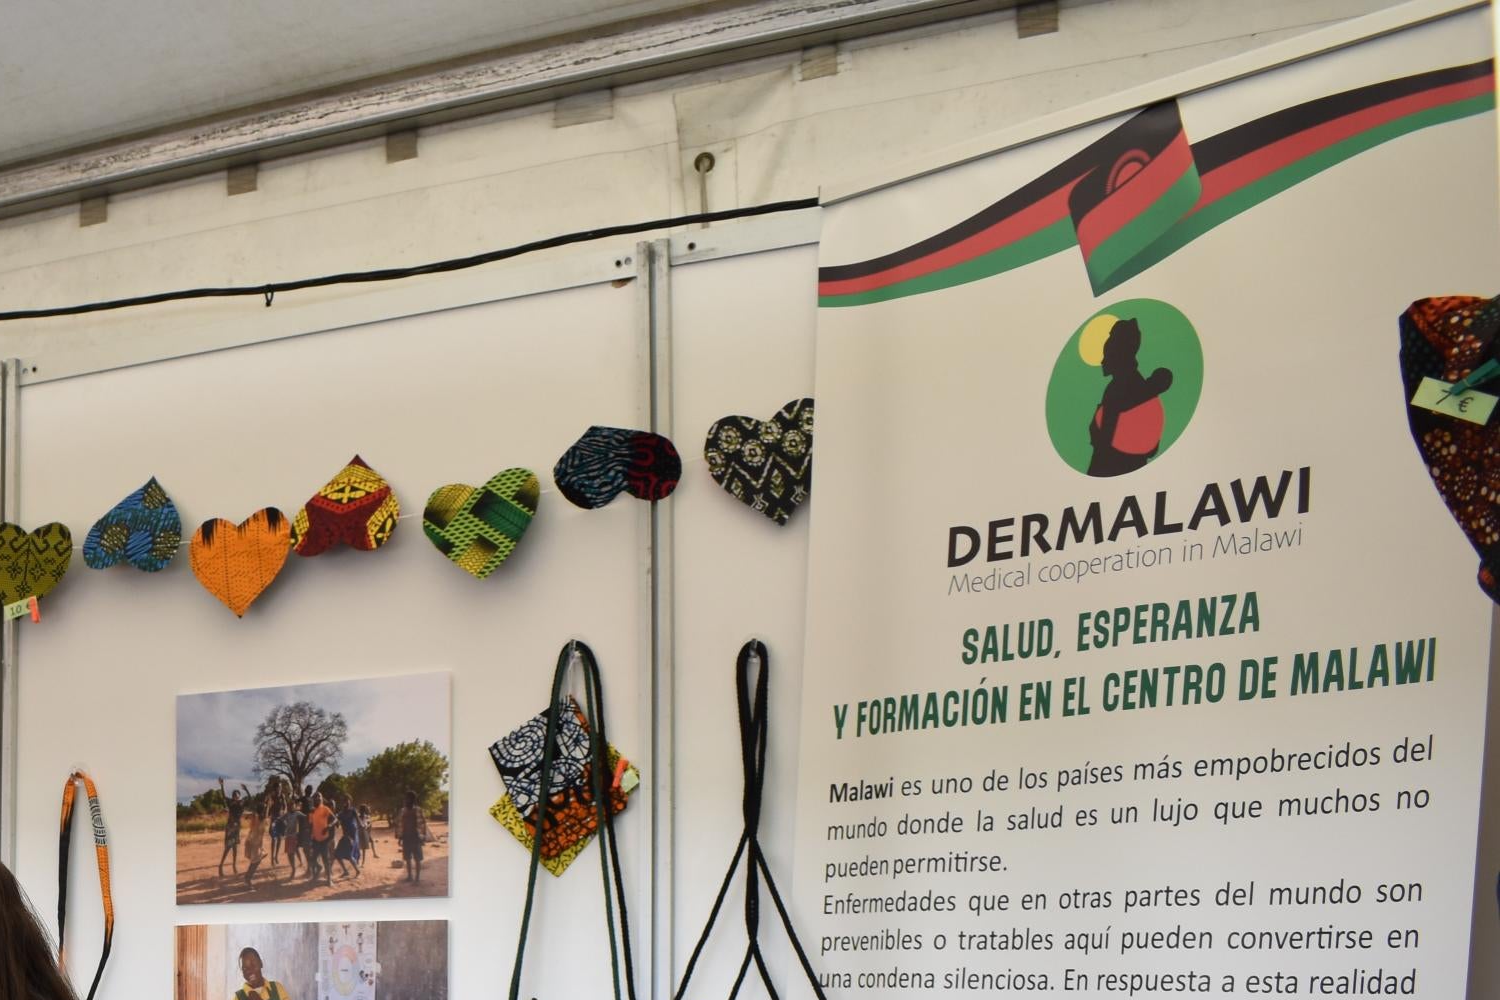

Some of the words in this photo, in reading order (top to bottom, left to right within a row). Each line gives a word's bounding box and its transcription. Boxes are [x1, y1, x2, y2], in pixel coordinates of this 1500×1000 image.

[1458, 397, 1474, 413] €
[947, 465, 1310, 567] DERMALAWI
[948, 562, 1033, 595] Medical
[1037, 543, 1172, 583] cooperation
[1183, 539, 1204, 562] in
[1212, 522, 1302, 559] Malawi
[10, 605, 22, 616] 10
[962, 618, 1061, 665] SALUD,
[1077, 592, 1259, 652] ESPERANZA
[834, 704, 848, 740] Y
[856, 677, 1008, 737] FORMACIÓN
[1019, 680, 1052, 721] EN
[1062, 676, 1090, 717] EL
[1103, 663, 1226, 712] CENTRO
[1238, 656, 1278, 701] DE
[1290, 637, 1436, 696] MALAWI
[829, 776, 894, 803] Malawi
[901, 780, 922, 796] es
[932, 777, 972, 794] uno
[983, 769, 1009, 792] de
[1019, 767, 1048, 790] los
[1057, 761, 1123, 792] países
[1134, 754, 1182, 780] más
[1194, 742, 1380, 781] empobrecidos
[1393, 734, 1433, 763] del
[828, 816, 887, 840] mundo
[897, 811, 963, 835] donde
[977, 810, 994, 832] la
[1007, 805, 1063, 830] salud
[1076, 809, 1097, 826] es
[1111, 806, 1137, 824] un
[1153, 798, 1198, 827] lujo
[1214, 800, 1262, 825] que
[1279, 788, 1380, 816] muchos
[1397, 790, 1429, 809] no
[825, 855, 889, 883] pueden
[893, 851, 1007, 879] permitirse.
[824, 889, 956, 914] Enfermedades
[969, 895, 1009, 917] que
[1021, 894, 1046, 910] en
[1059, 889, 1112, 909] otras
[1124, 886, 1200, 913] partes
[1215, 881, 1254, 906] del
[1269, 878, 1361, 905] mundo
[1376, 883, 1422, 903] son
[821, 928, 922, 957] prevenibles
[933, 934, 947, 950] o
[958, 928, 1054, 950] tratables
[1064, 925, 1111, 955] aquí
[1121, 925, 1212, 955] pueden
[1227, 924, 1372, 949] convertirse
[1387, 929, 1418, 948] en
[818, 972, 852, 988] una
[858, 966, 935, 989] condena
[943, 967, 1054, 990] silenciosa.
[1064, 969, 1088, 991] En
[1097, 971, 1211, 997] respuesta
[1222, 975, 1234, 992] a
[1246, 972, 1298, 994] esta
[1309, 968, 1416, 995] realidad
